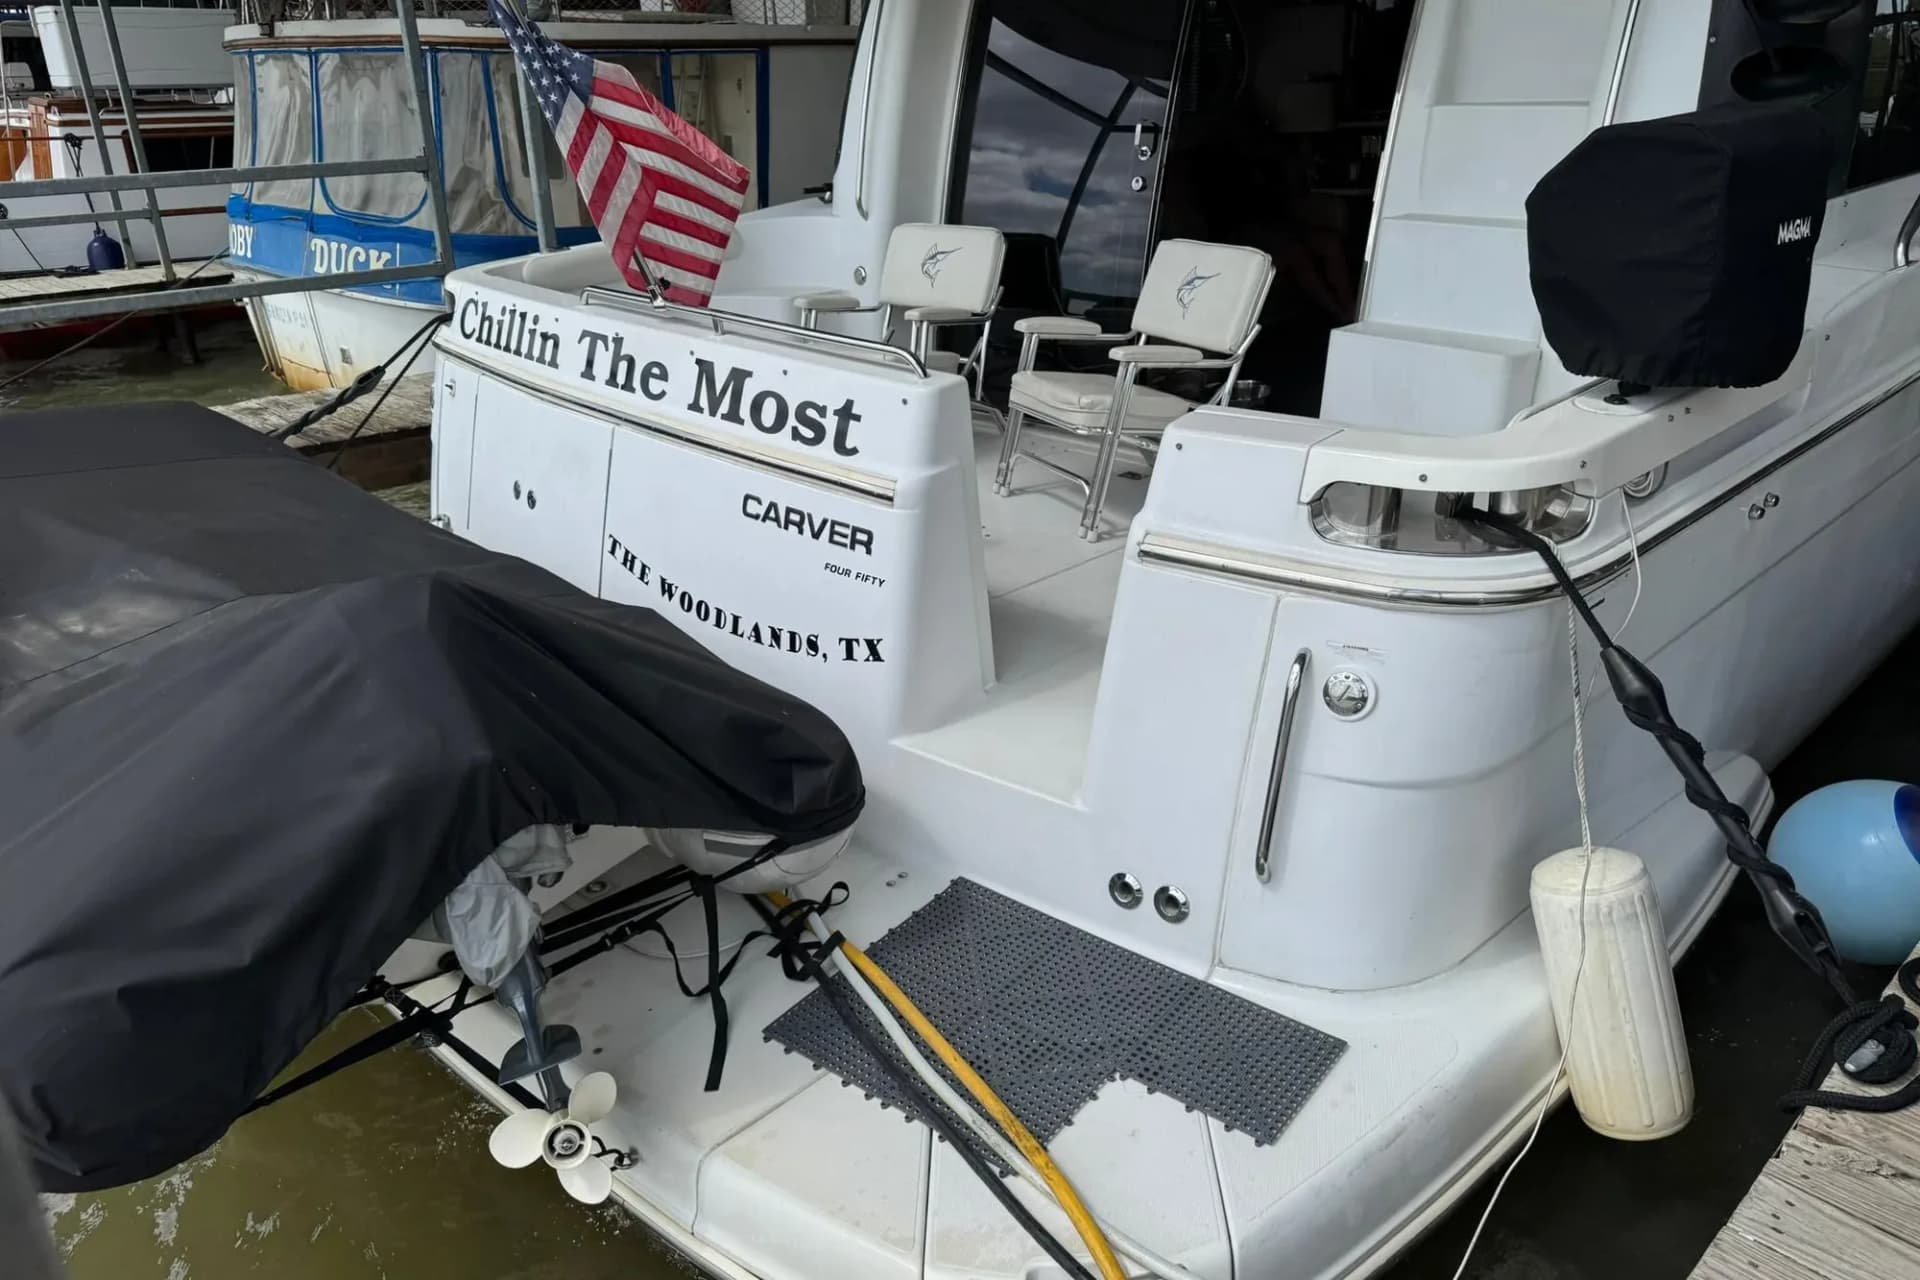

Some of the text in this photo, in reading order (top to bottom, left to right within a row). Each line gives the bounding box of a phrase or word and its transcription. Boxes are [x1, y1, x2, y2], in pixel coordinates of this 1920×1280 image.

[1777, 216, 1812, 245] MAGMA
[310, 238, 392, 288] DUCK
[460, 298, 862, 457] Chillin The Most
[742, 493, 874, 556] CARVER
[608, 534, 886, 663] THE WOODLANDS, TX
[824, 562, 886, 588] FOUR FIFTY
